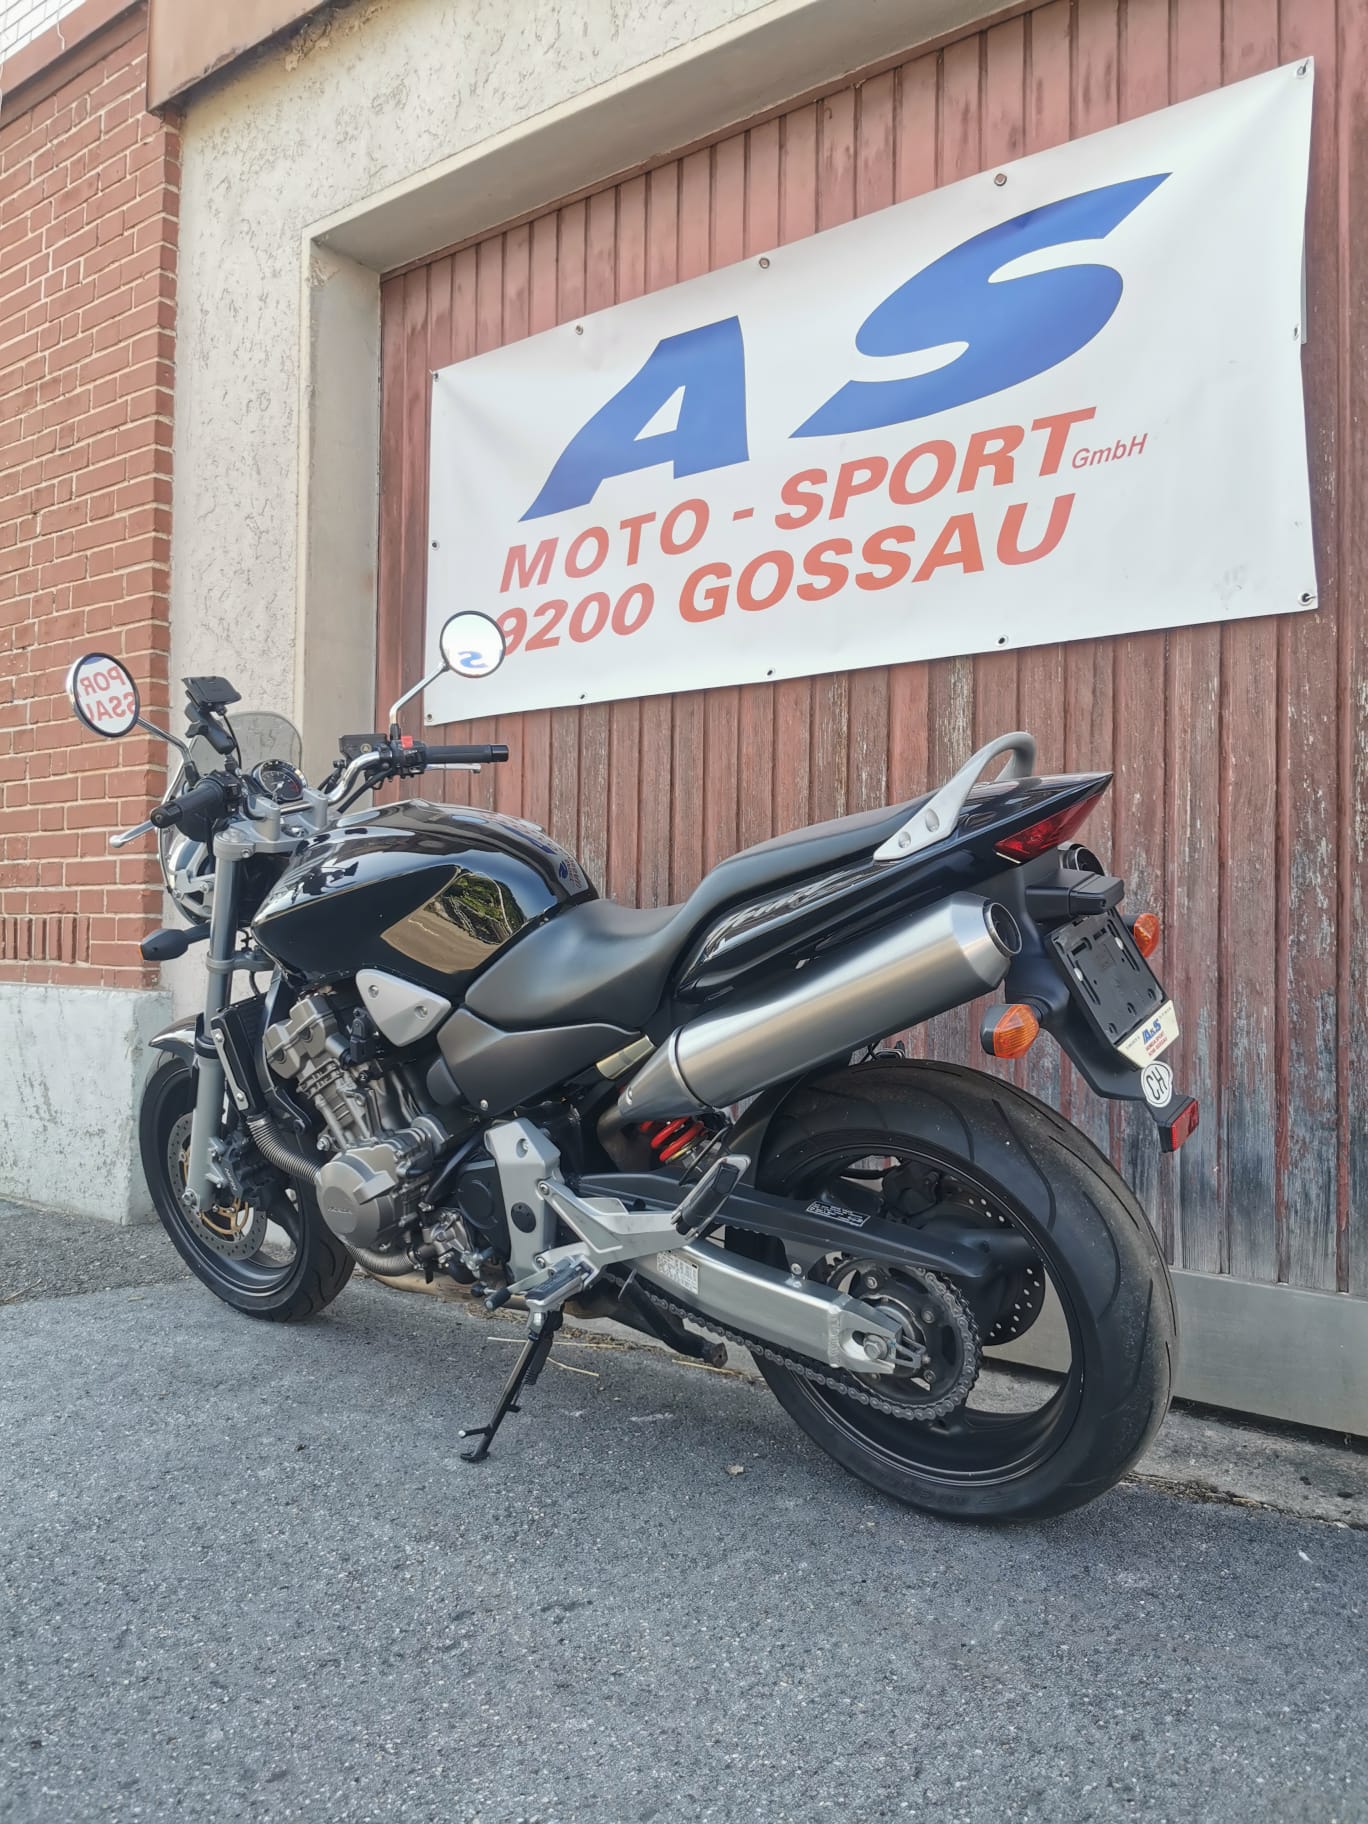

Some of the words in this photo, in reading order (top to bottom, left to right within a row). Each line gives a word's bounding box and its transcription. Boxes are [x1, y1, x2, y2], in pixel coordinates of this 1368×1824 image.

[492, 582, 654, 657] 9200
[678, 493, 1076, 623] GOSSAU
[500, 499, 711, 592] MOTO
[774, 406, 1097, 530] SPORT
[1071, 432, 1149, 470] GmbH
[1146, 1066, 1168, 1100] CH
